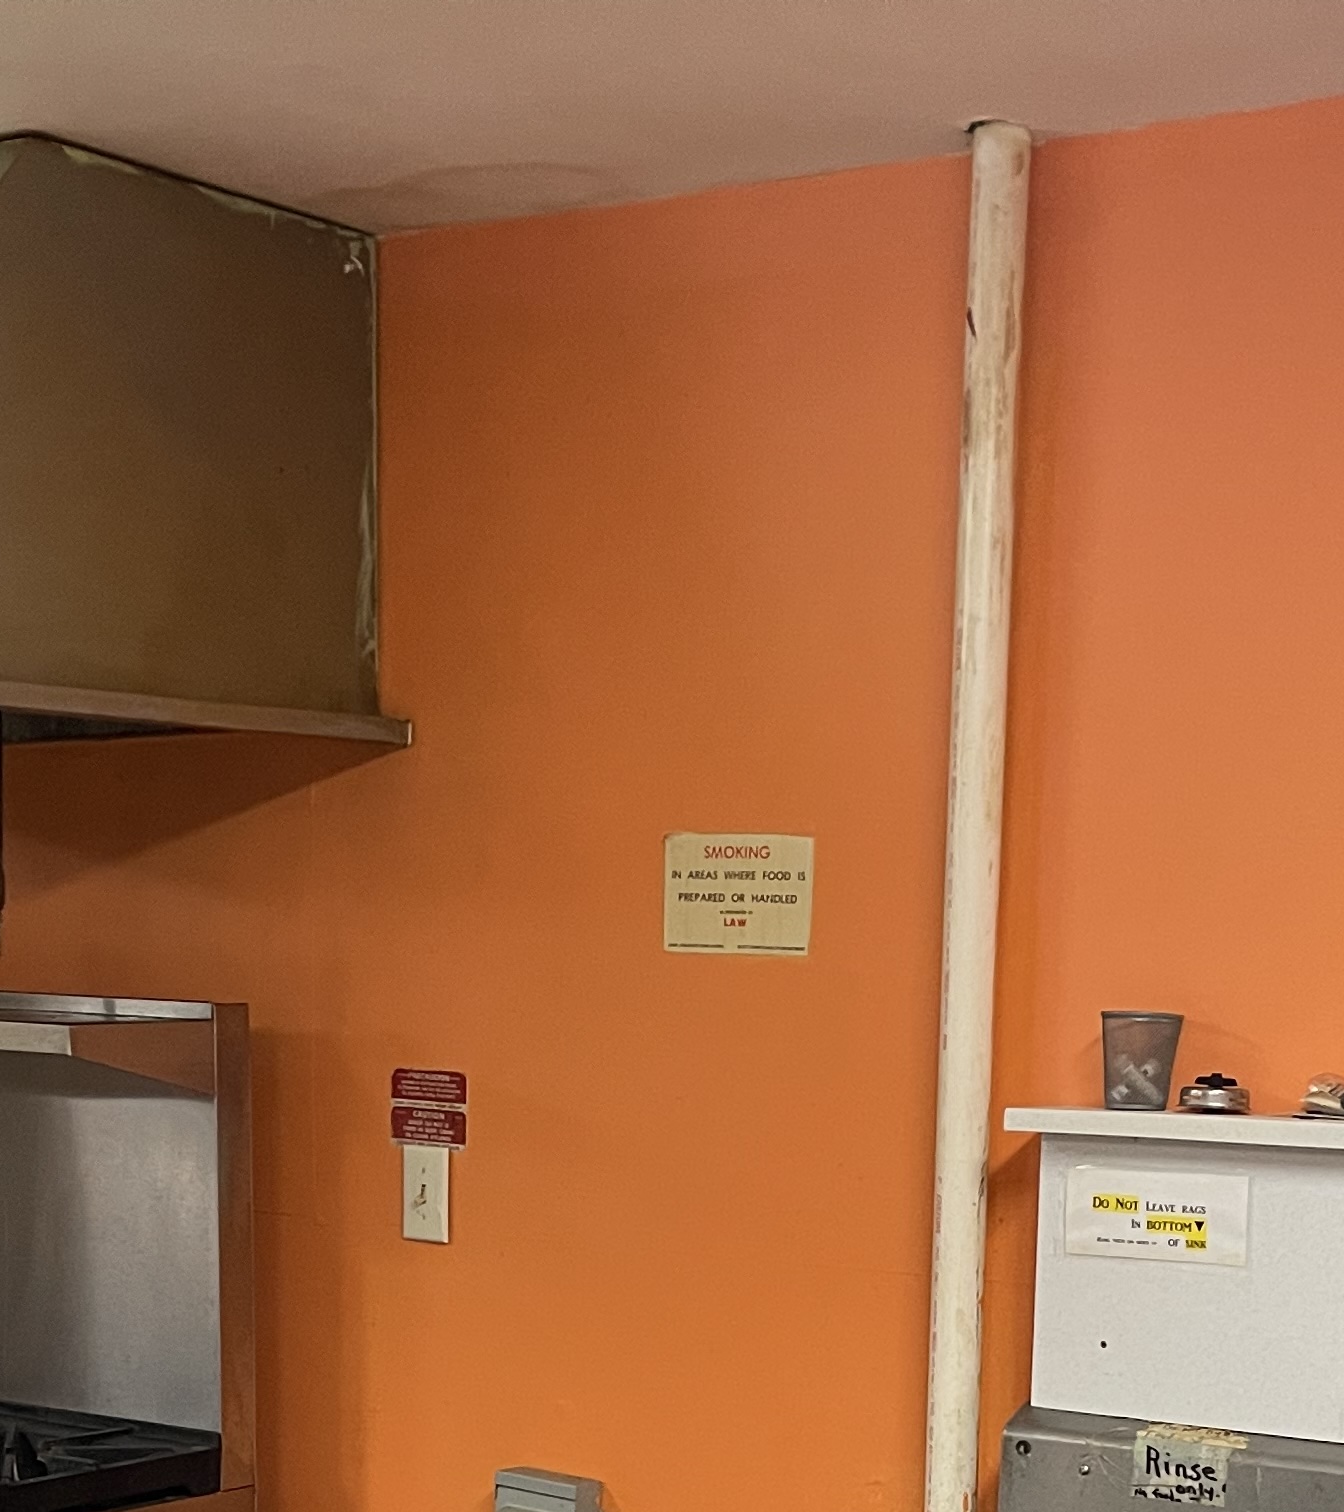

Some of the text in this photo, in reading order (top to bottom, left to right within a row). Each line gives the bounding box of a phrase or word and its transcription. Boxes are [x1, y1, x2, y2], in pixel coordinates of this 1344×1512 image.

[704, 845, 771, 859] SMOKING
[671, 869, 806, 881] IN AREAS WHERE FOOD IS
[678, 892, 798, 904] PREPARED OR HANDLED
[723, 917, 747, 927] LAW
[1146, 1220, 1193, 1233] BOTTOM
[1145, 1445, 1218, 1482] Rinse
